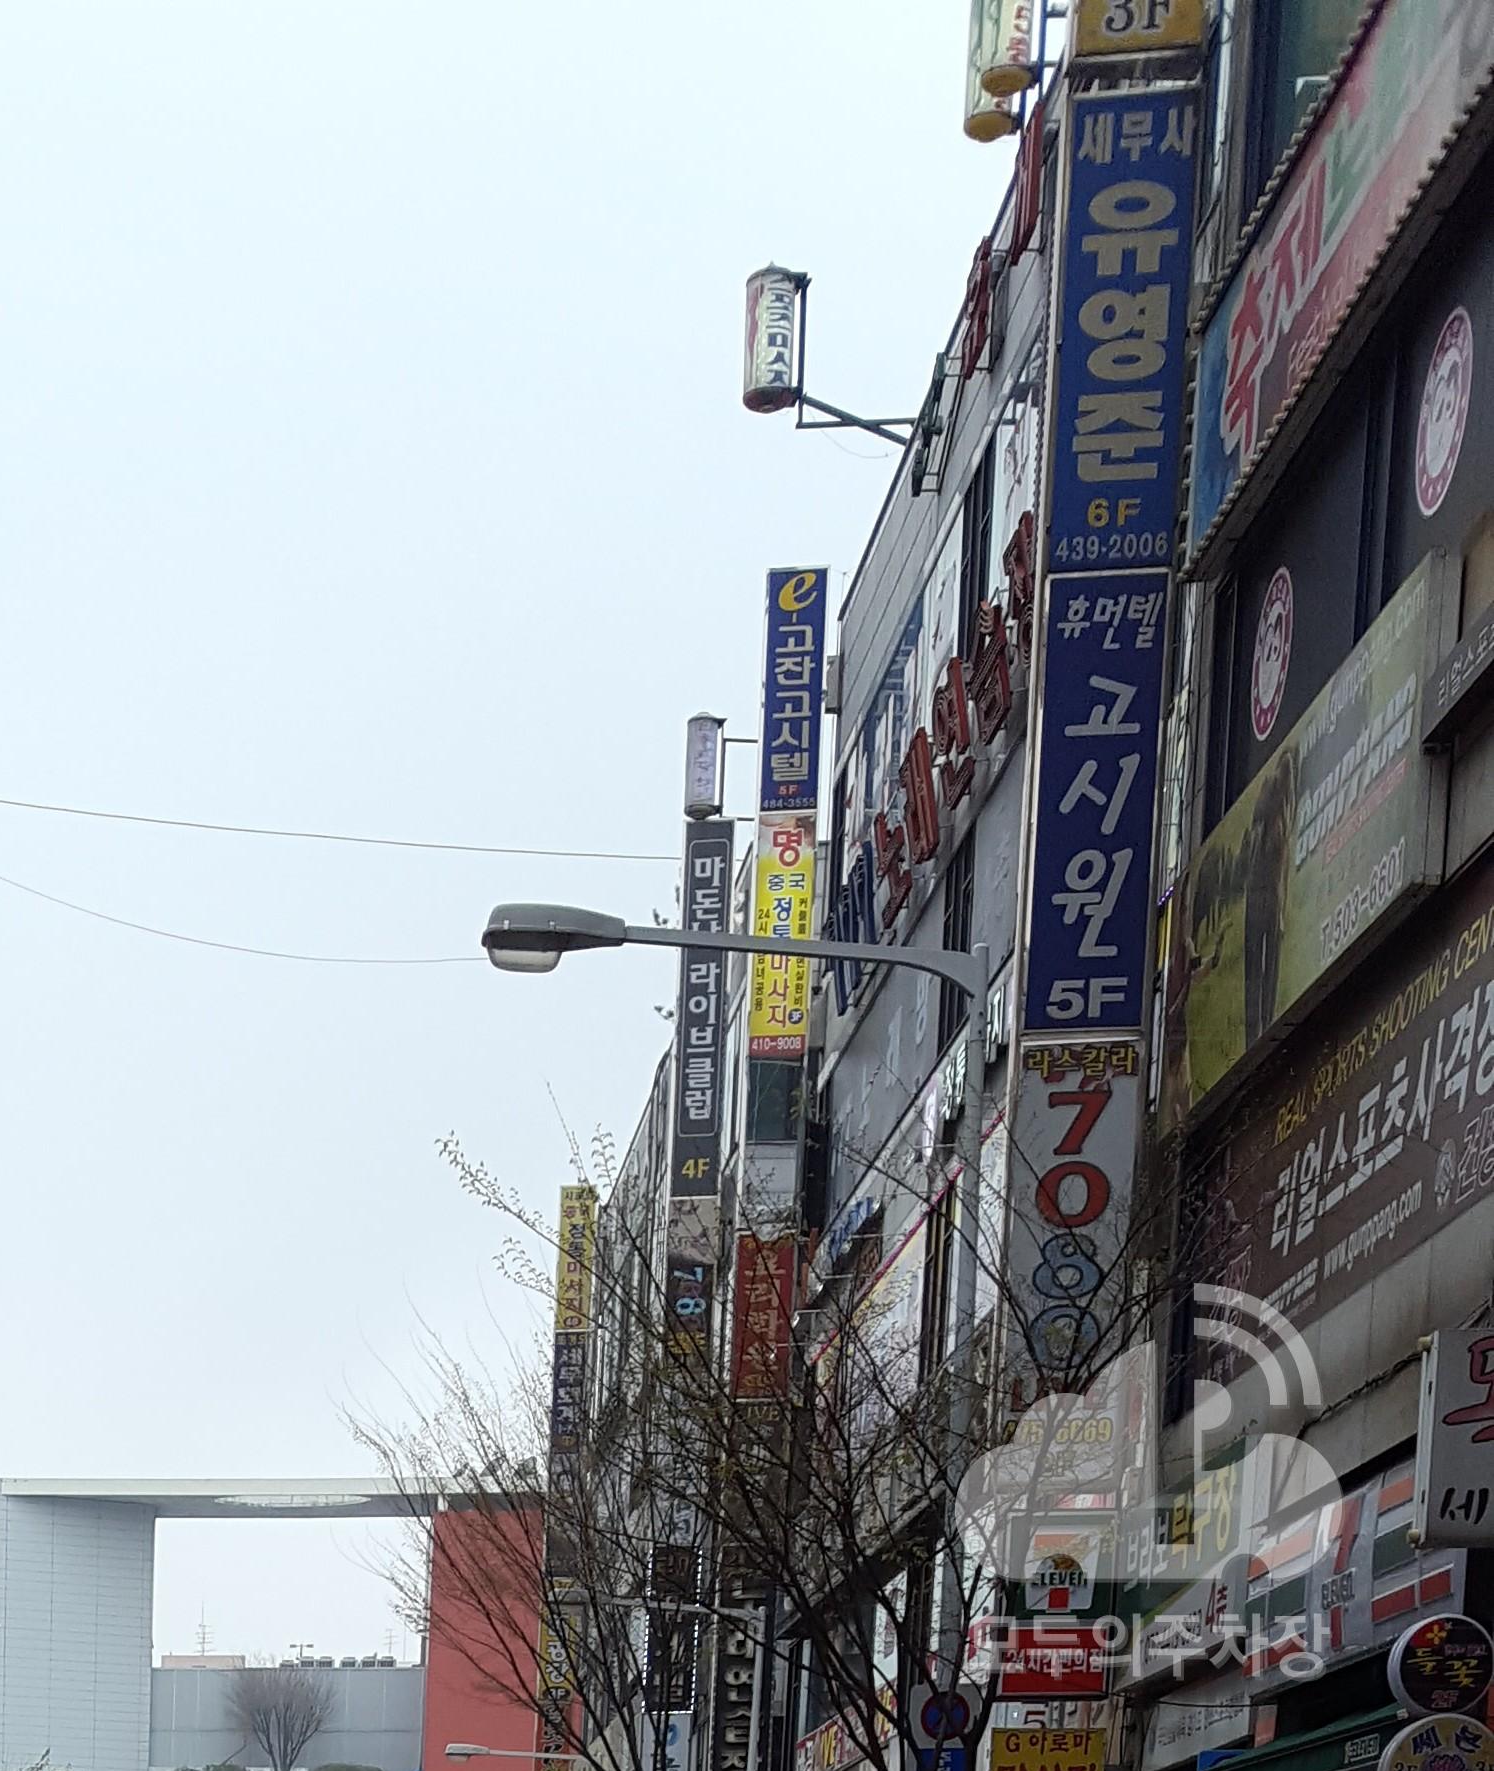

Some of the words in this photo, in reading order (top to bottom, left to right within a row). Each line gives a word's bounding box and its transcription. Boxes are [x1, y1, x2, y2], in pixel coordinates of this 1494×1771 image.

[1078, 105, 1195, 164] 세무사
[1072, 180, 1179, 482] 유영준
[1087, 496, 1142, 528] 6F
[1056, 532, 1169, 562] 439-2006
[1057, 592, 1163, 651] 휴먼텔
[1051, 674, 1141, 958] 고시원
[773, 828, 803, 867] 명
[768, 873, 806, 891] 중국
[1045, 977, 1128, 1020] 5F
[684, 961, 721, 1121] 라이브클럽
[681, 1157, 710, 1180] 4F
[1028, 1730, 1092, 1756] 아로마
